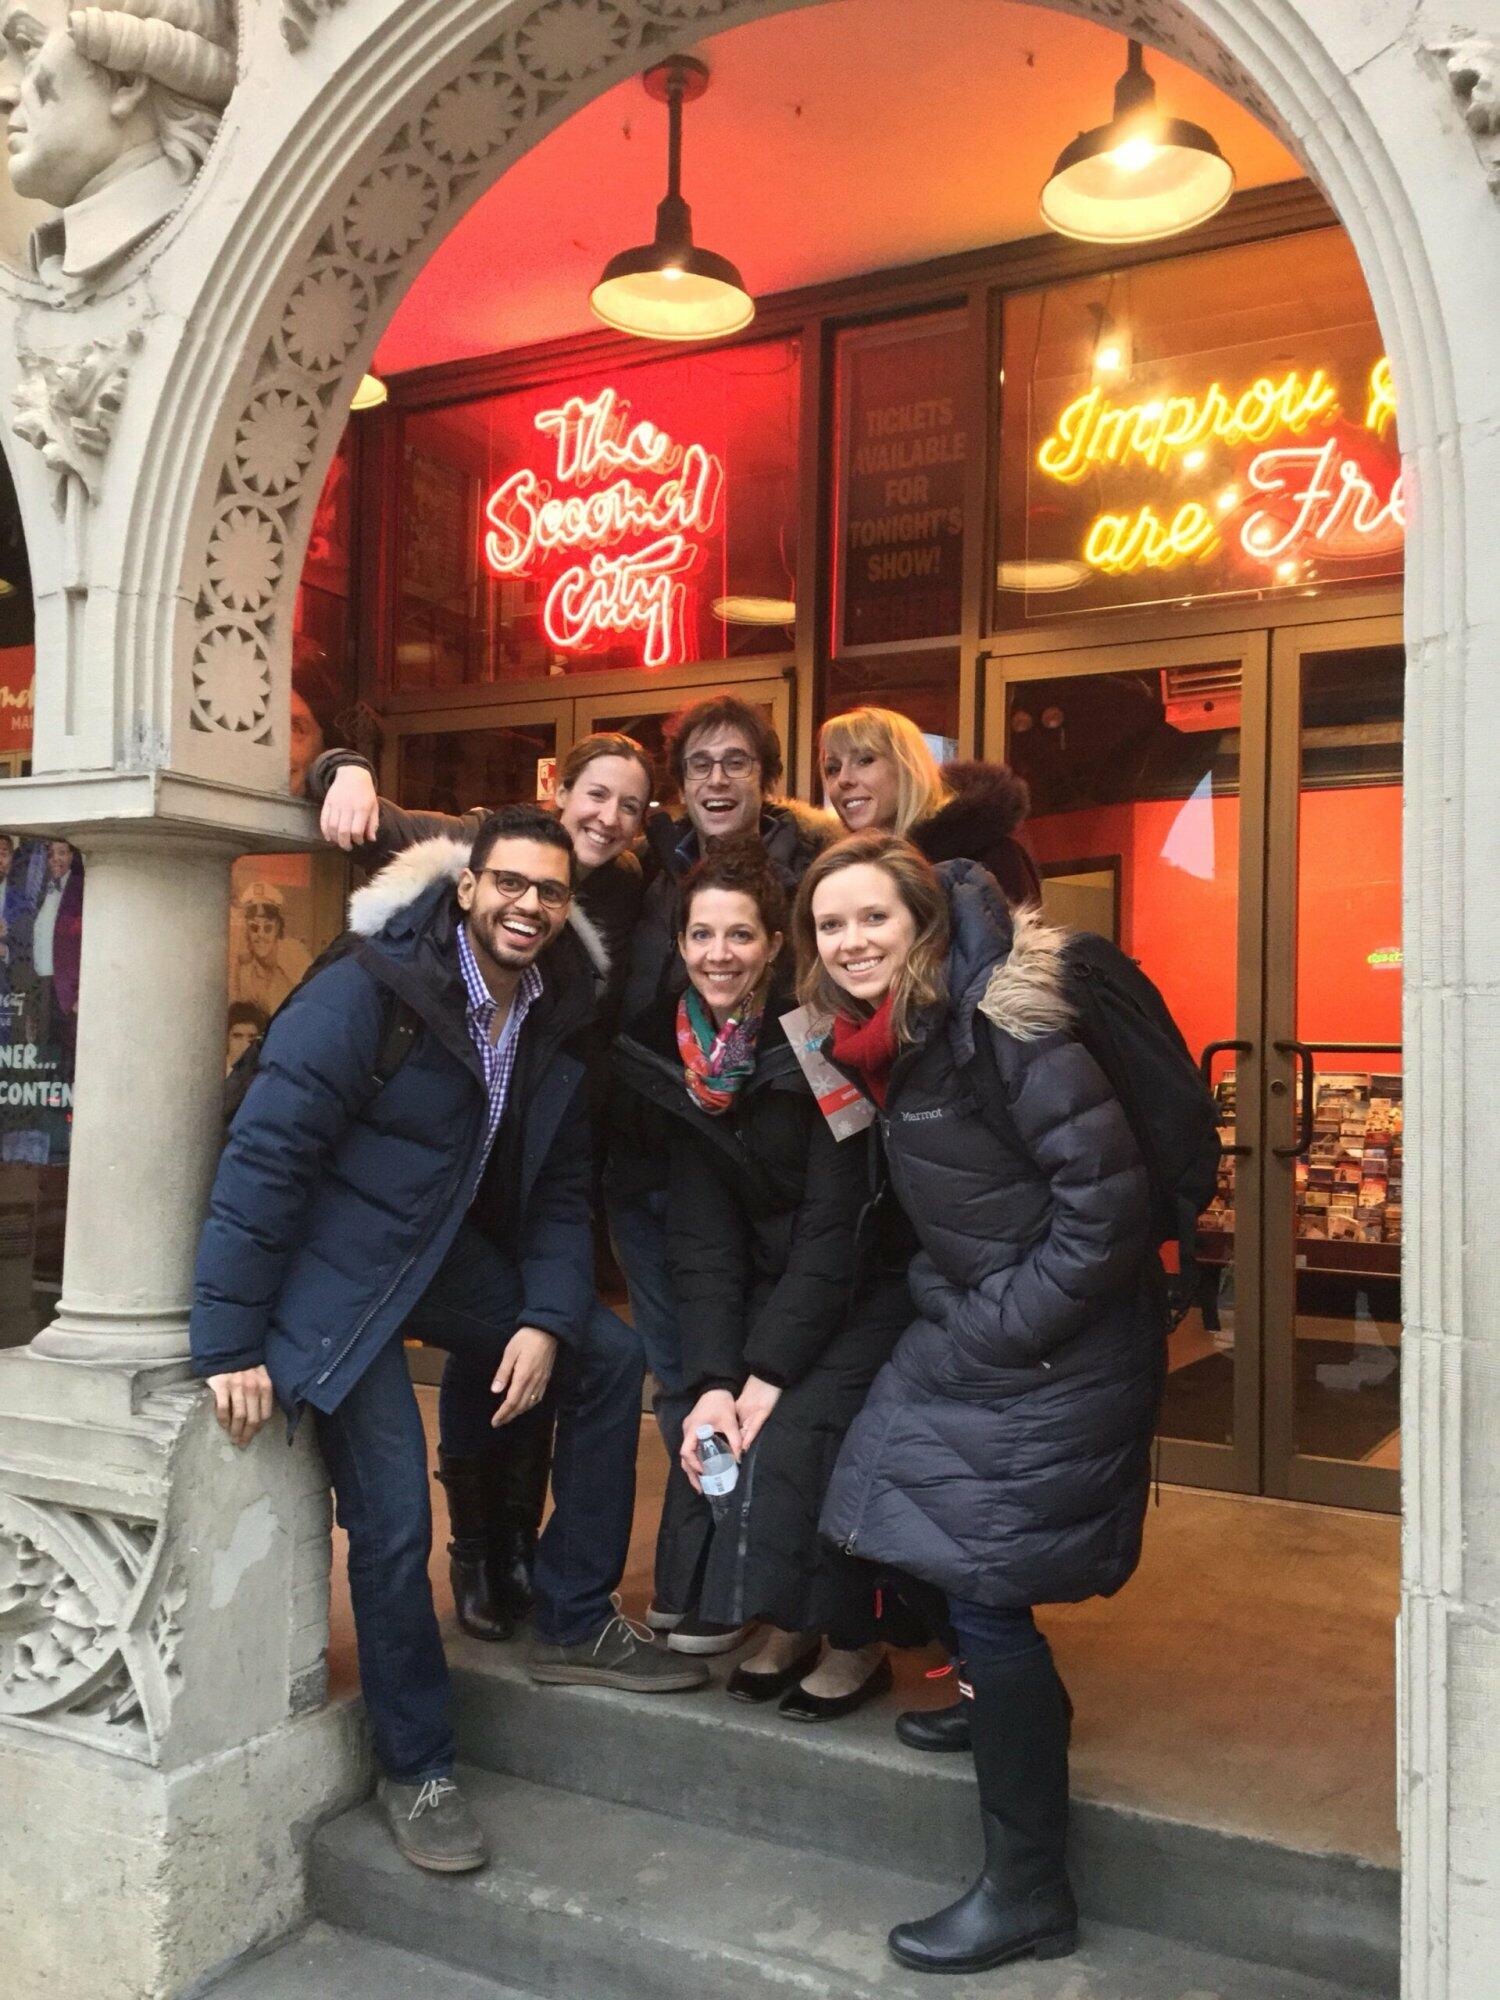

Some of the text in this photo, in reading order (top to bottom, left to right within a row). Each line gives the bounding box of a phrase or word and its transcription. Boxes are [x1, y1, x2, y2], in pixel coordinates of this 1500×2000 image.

[534, 387, 670, 482] The
[866, 397, 954, 438] TICKETS
[1037, 369, 1336, 475] Improv
[854, 431, 968, 475] AVAILABLE
[485, 443, 709, 573] Second
[884, 474, 930, 508] FOR
[850, 506, 963, 548] TONIGHT'S
[1083, 501, 1215, 566] are
[867, 545, 943, 582] SHOW!
[543, 534, 685, 667] City
[901, 1108, 943, 1122] Marmot
